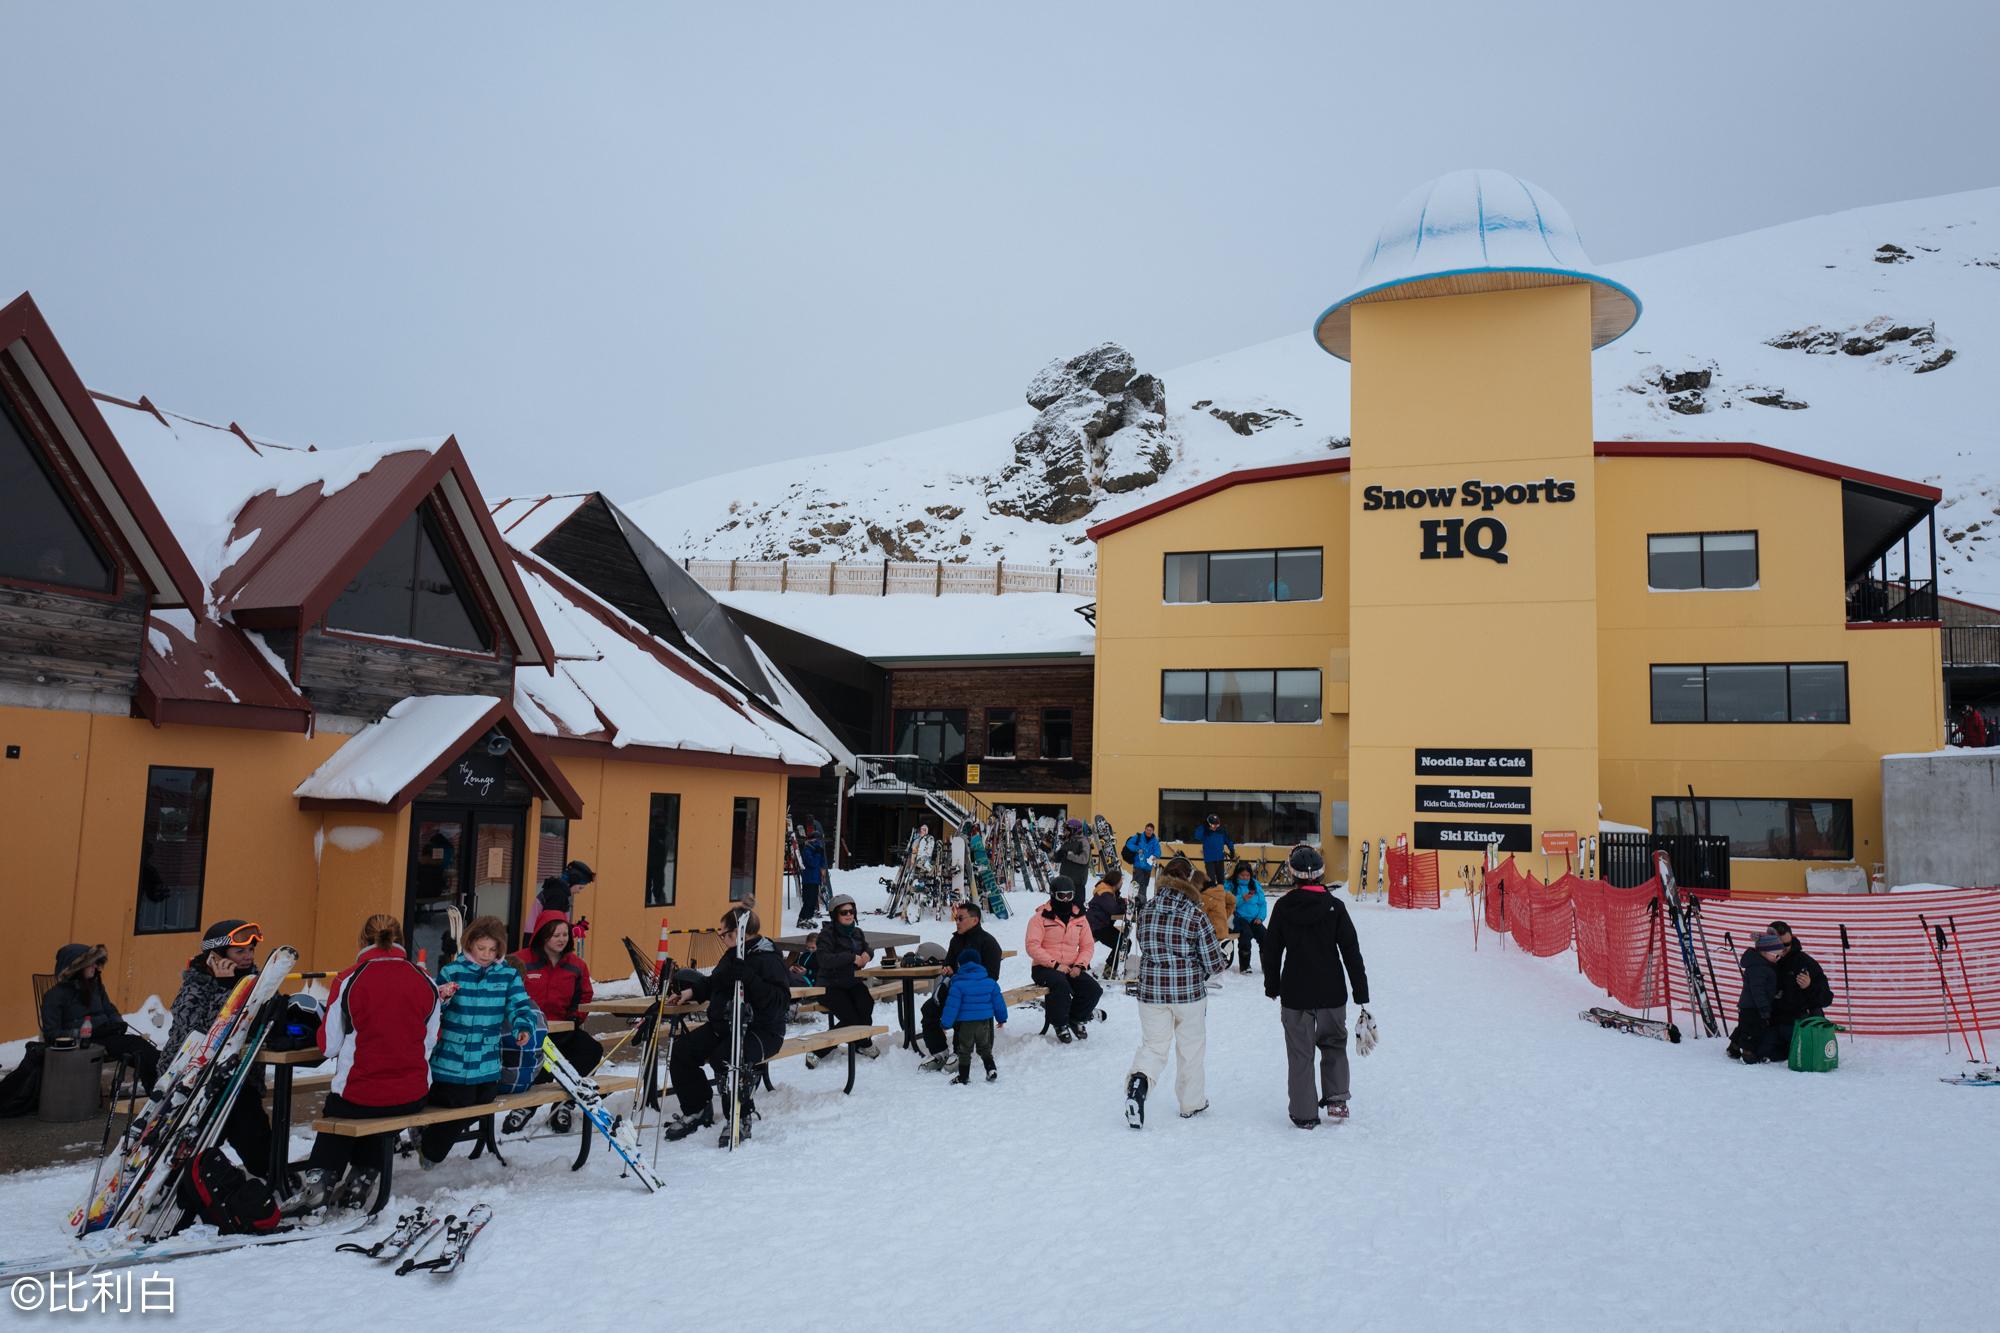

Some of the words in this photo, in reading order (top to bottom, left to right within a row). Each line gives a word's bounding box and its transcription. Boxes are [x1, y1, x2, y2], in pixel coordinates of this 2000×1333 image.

[1363, 485, 1457, 511] Snow
[1461, 477, 1576, 511] Sports
[1420, 517, 1509, 565] HQ
[459, 761, 473, 773] The
[1421, 756, 1464, 767] Noodle
[1465, 757, 1487, 767] Bar
[1488, 757, 1498, 768] &
[1498, 757, 1526, 768] Café
[463, 770, 495, 796] Lounge
[1448, 789, 1471, 799] The
[1471, 789, 1495, 800] Den
[1423, 800, 1439, 808] Kids
[1440, 800, 1457, 809] Club,
[1490, 801, 1526, 809] Lowriders
[1440, 830, 1462, 842] Ski
[1463, 831, 1505, 844] Kindy
